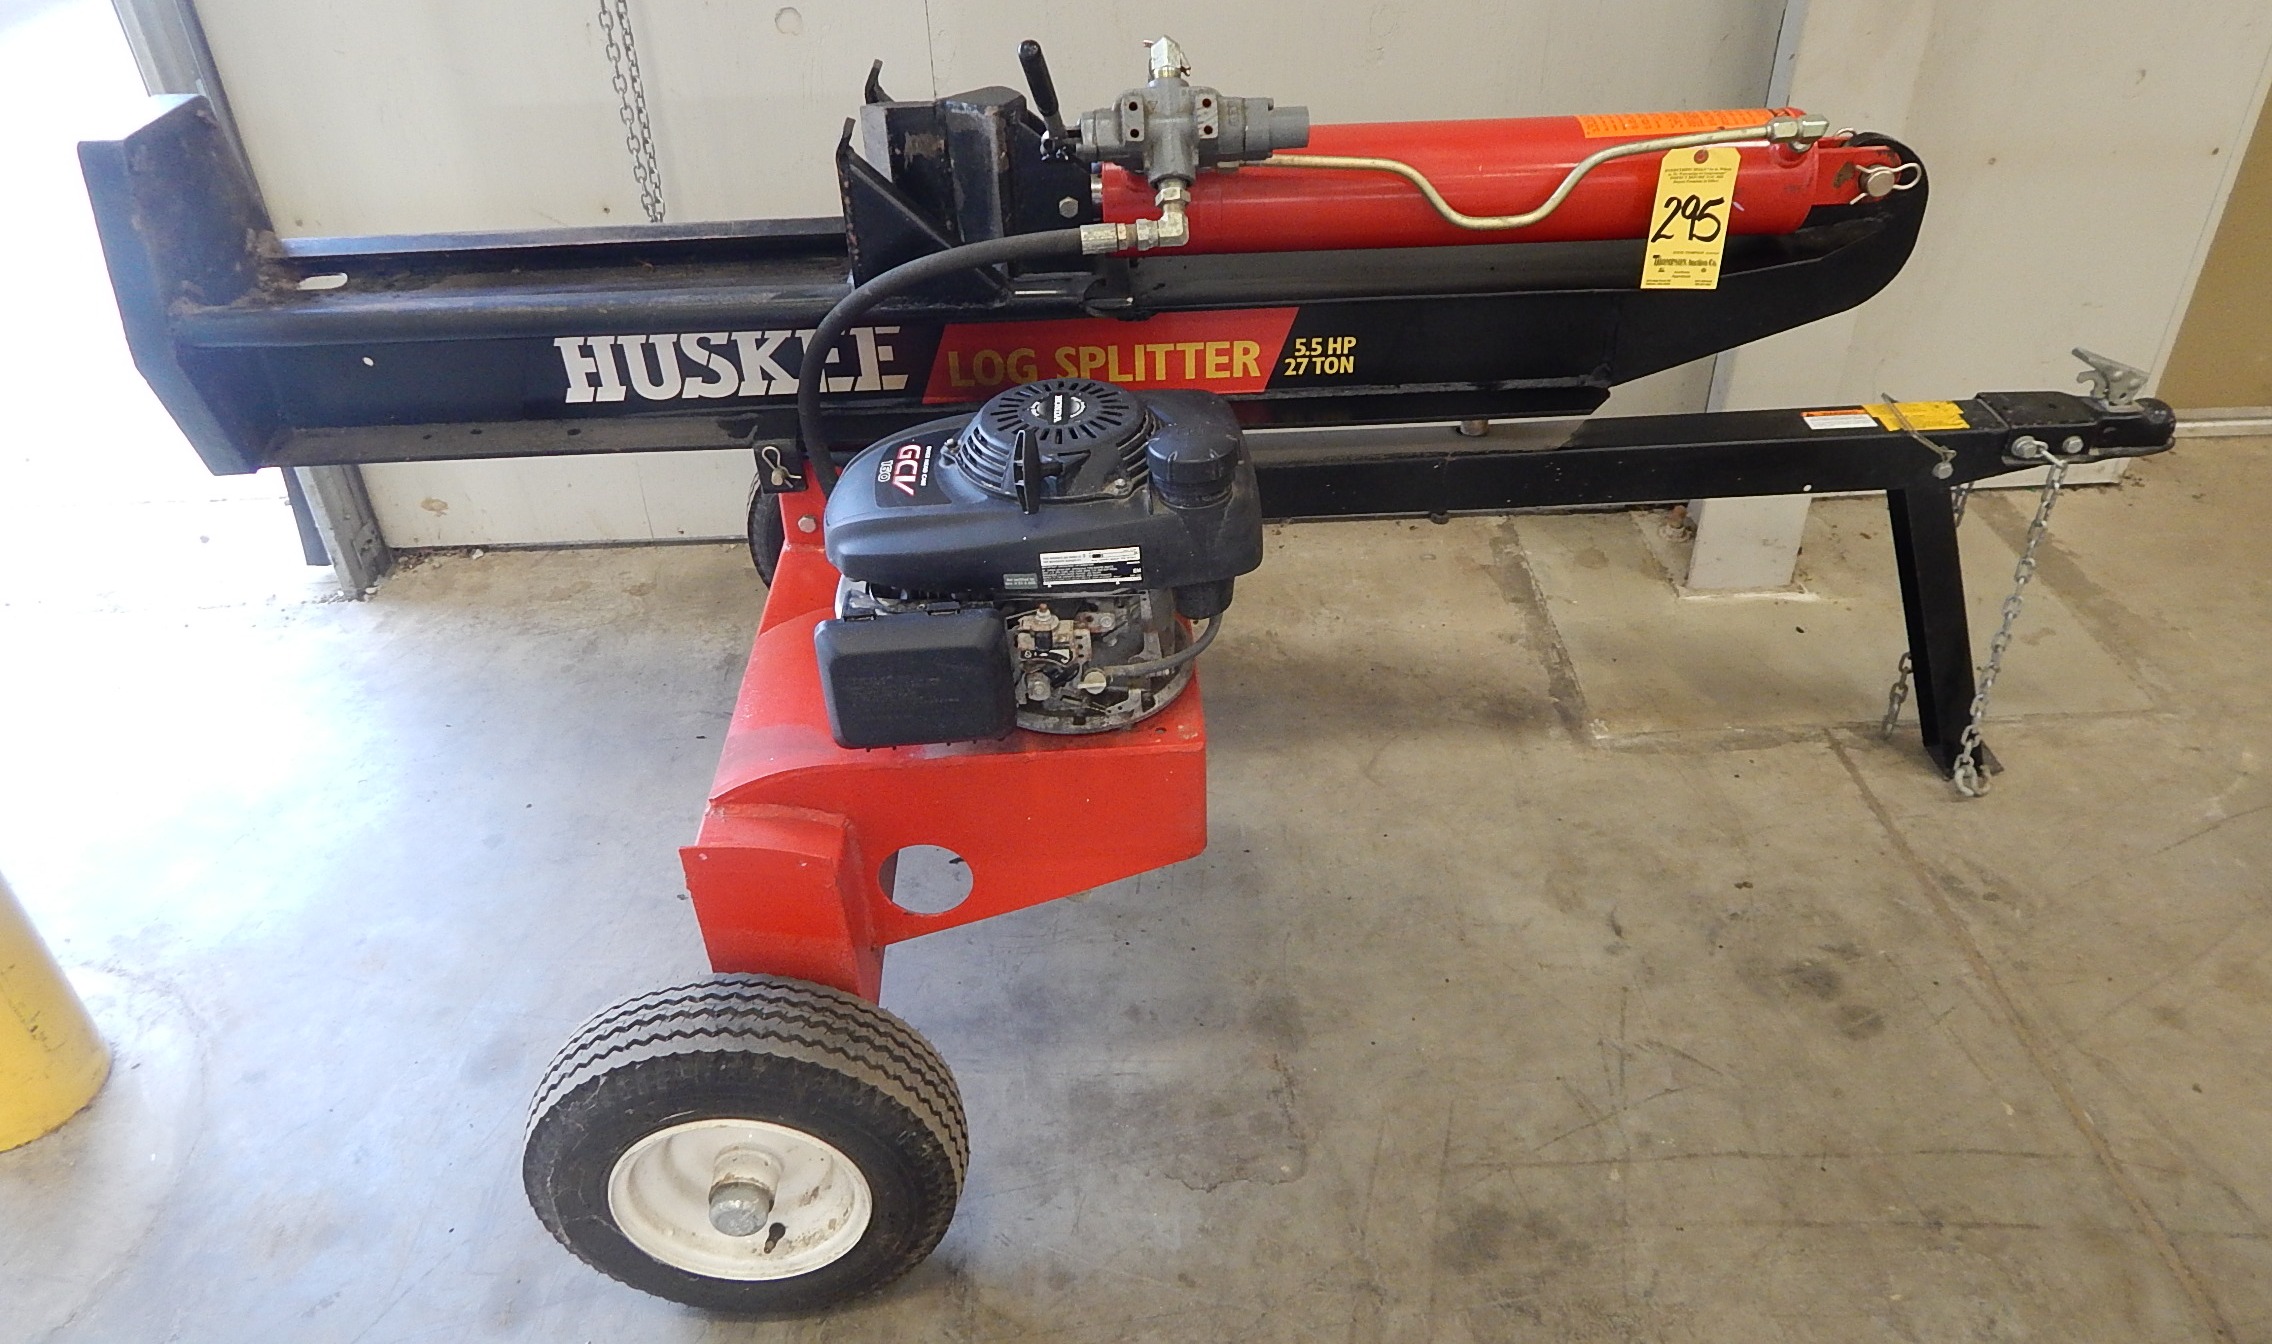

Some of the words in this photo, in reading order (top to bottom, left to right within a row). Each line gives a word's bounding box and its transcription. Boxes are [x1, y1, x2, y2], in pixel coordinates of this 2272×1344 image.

[1651, 195, 1726, 243] 295
[947, 348, 1036, 387] LOG
[1053, 340, 1262, 383] SPLITTER
[1294, 338, 1323, 356] 5.5
[1328, 336, 1357, 355] HP
[1283, 357, 1308, 376] 27
[1311, 356, 1355, 375] TON
[877, 459, 895, 483] 160
[891, 443, 922, 497] GCV
